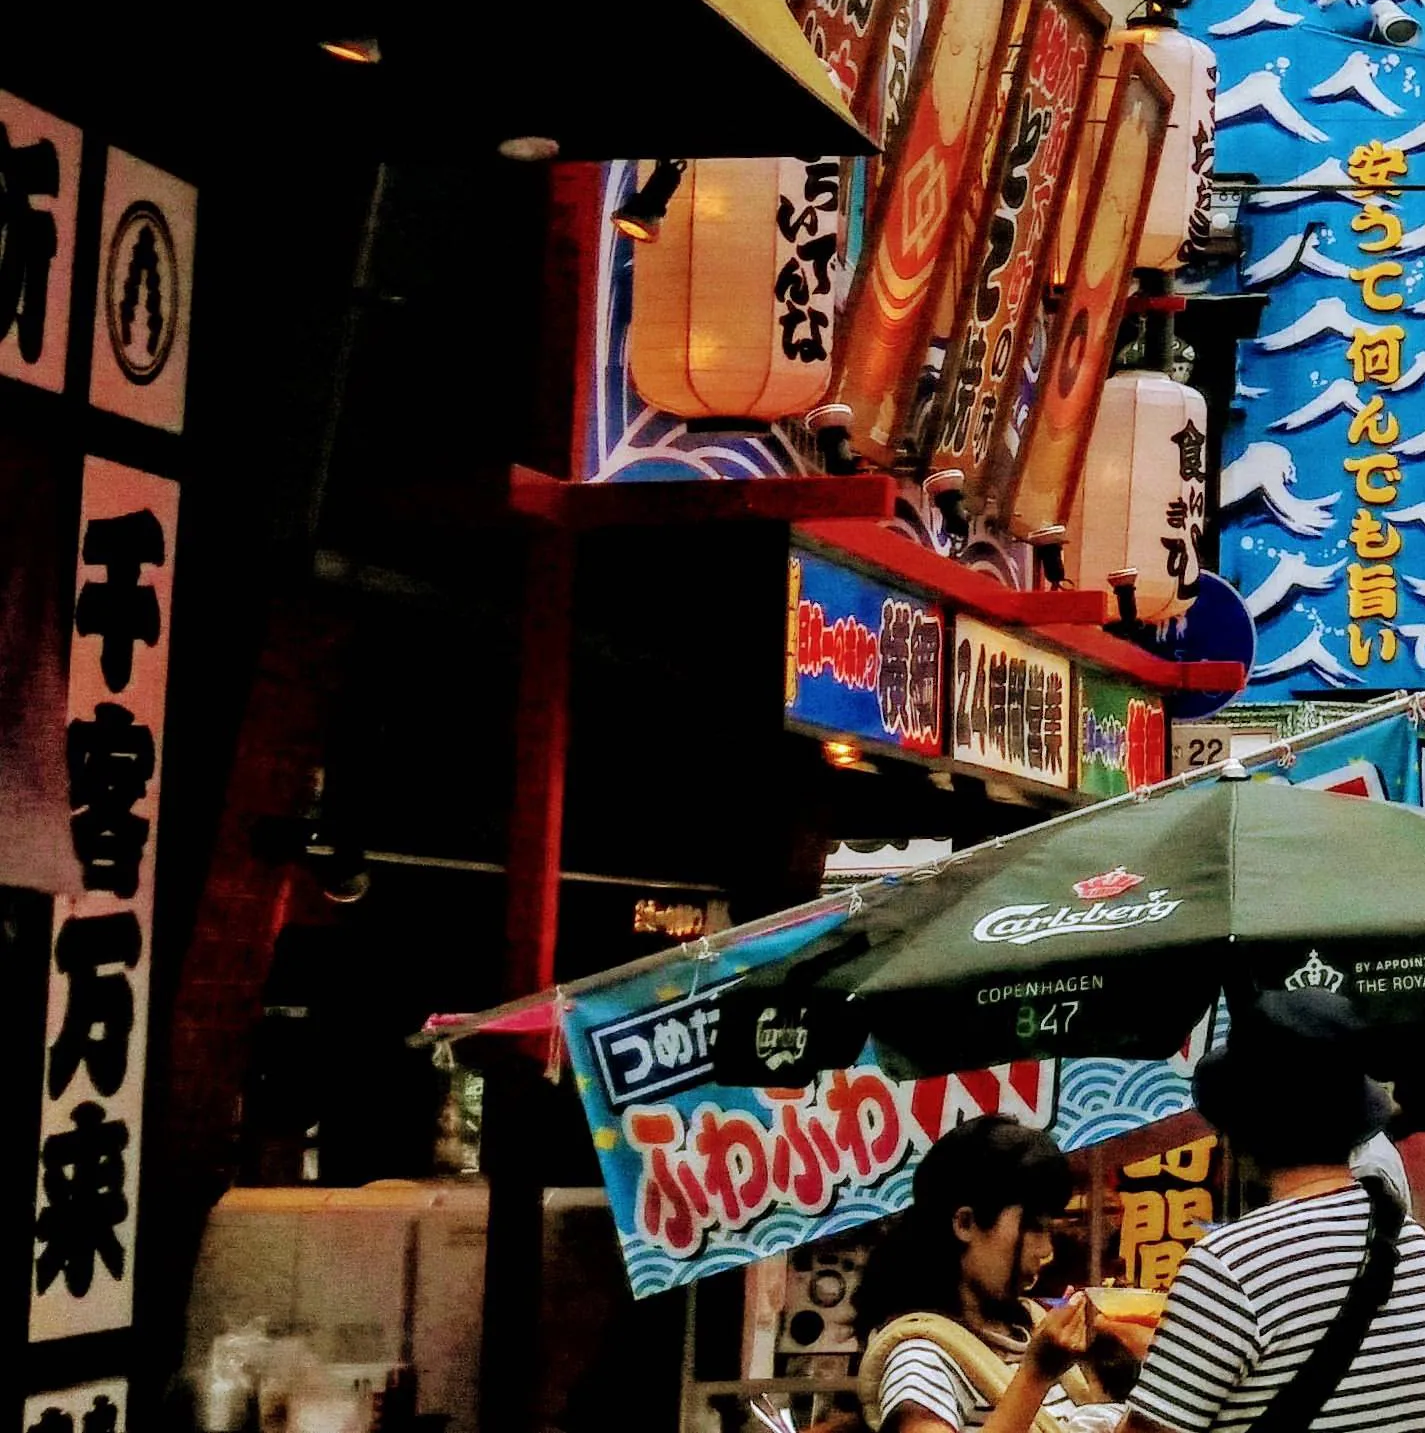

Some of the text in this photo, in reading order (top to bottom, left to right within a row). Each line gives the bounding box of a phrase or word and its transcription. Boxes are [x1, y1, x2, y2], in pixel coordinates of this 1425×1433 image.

[1346, 142, 1409, 668] 安うて何んでも旨い
[957, 638, 1063, 776] 24時間営業
[972, 888, 1183, 946] Carlsberg
[1355, 962, 1370, 973] BY
[1357, 978, 1387, 993] THE
[978, 975, 1104, 1005] COPENHAGEN
